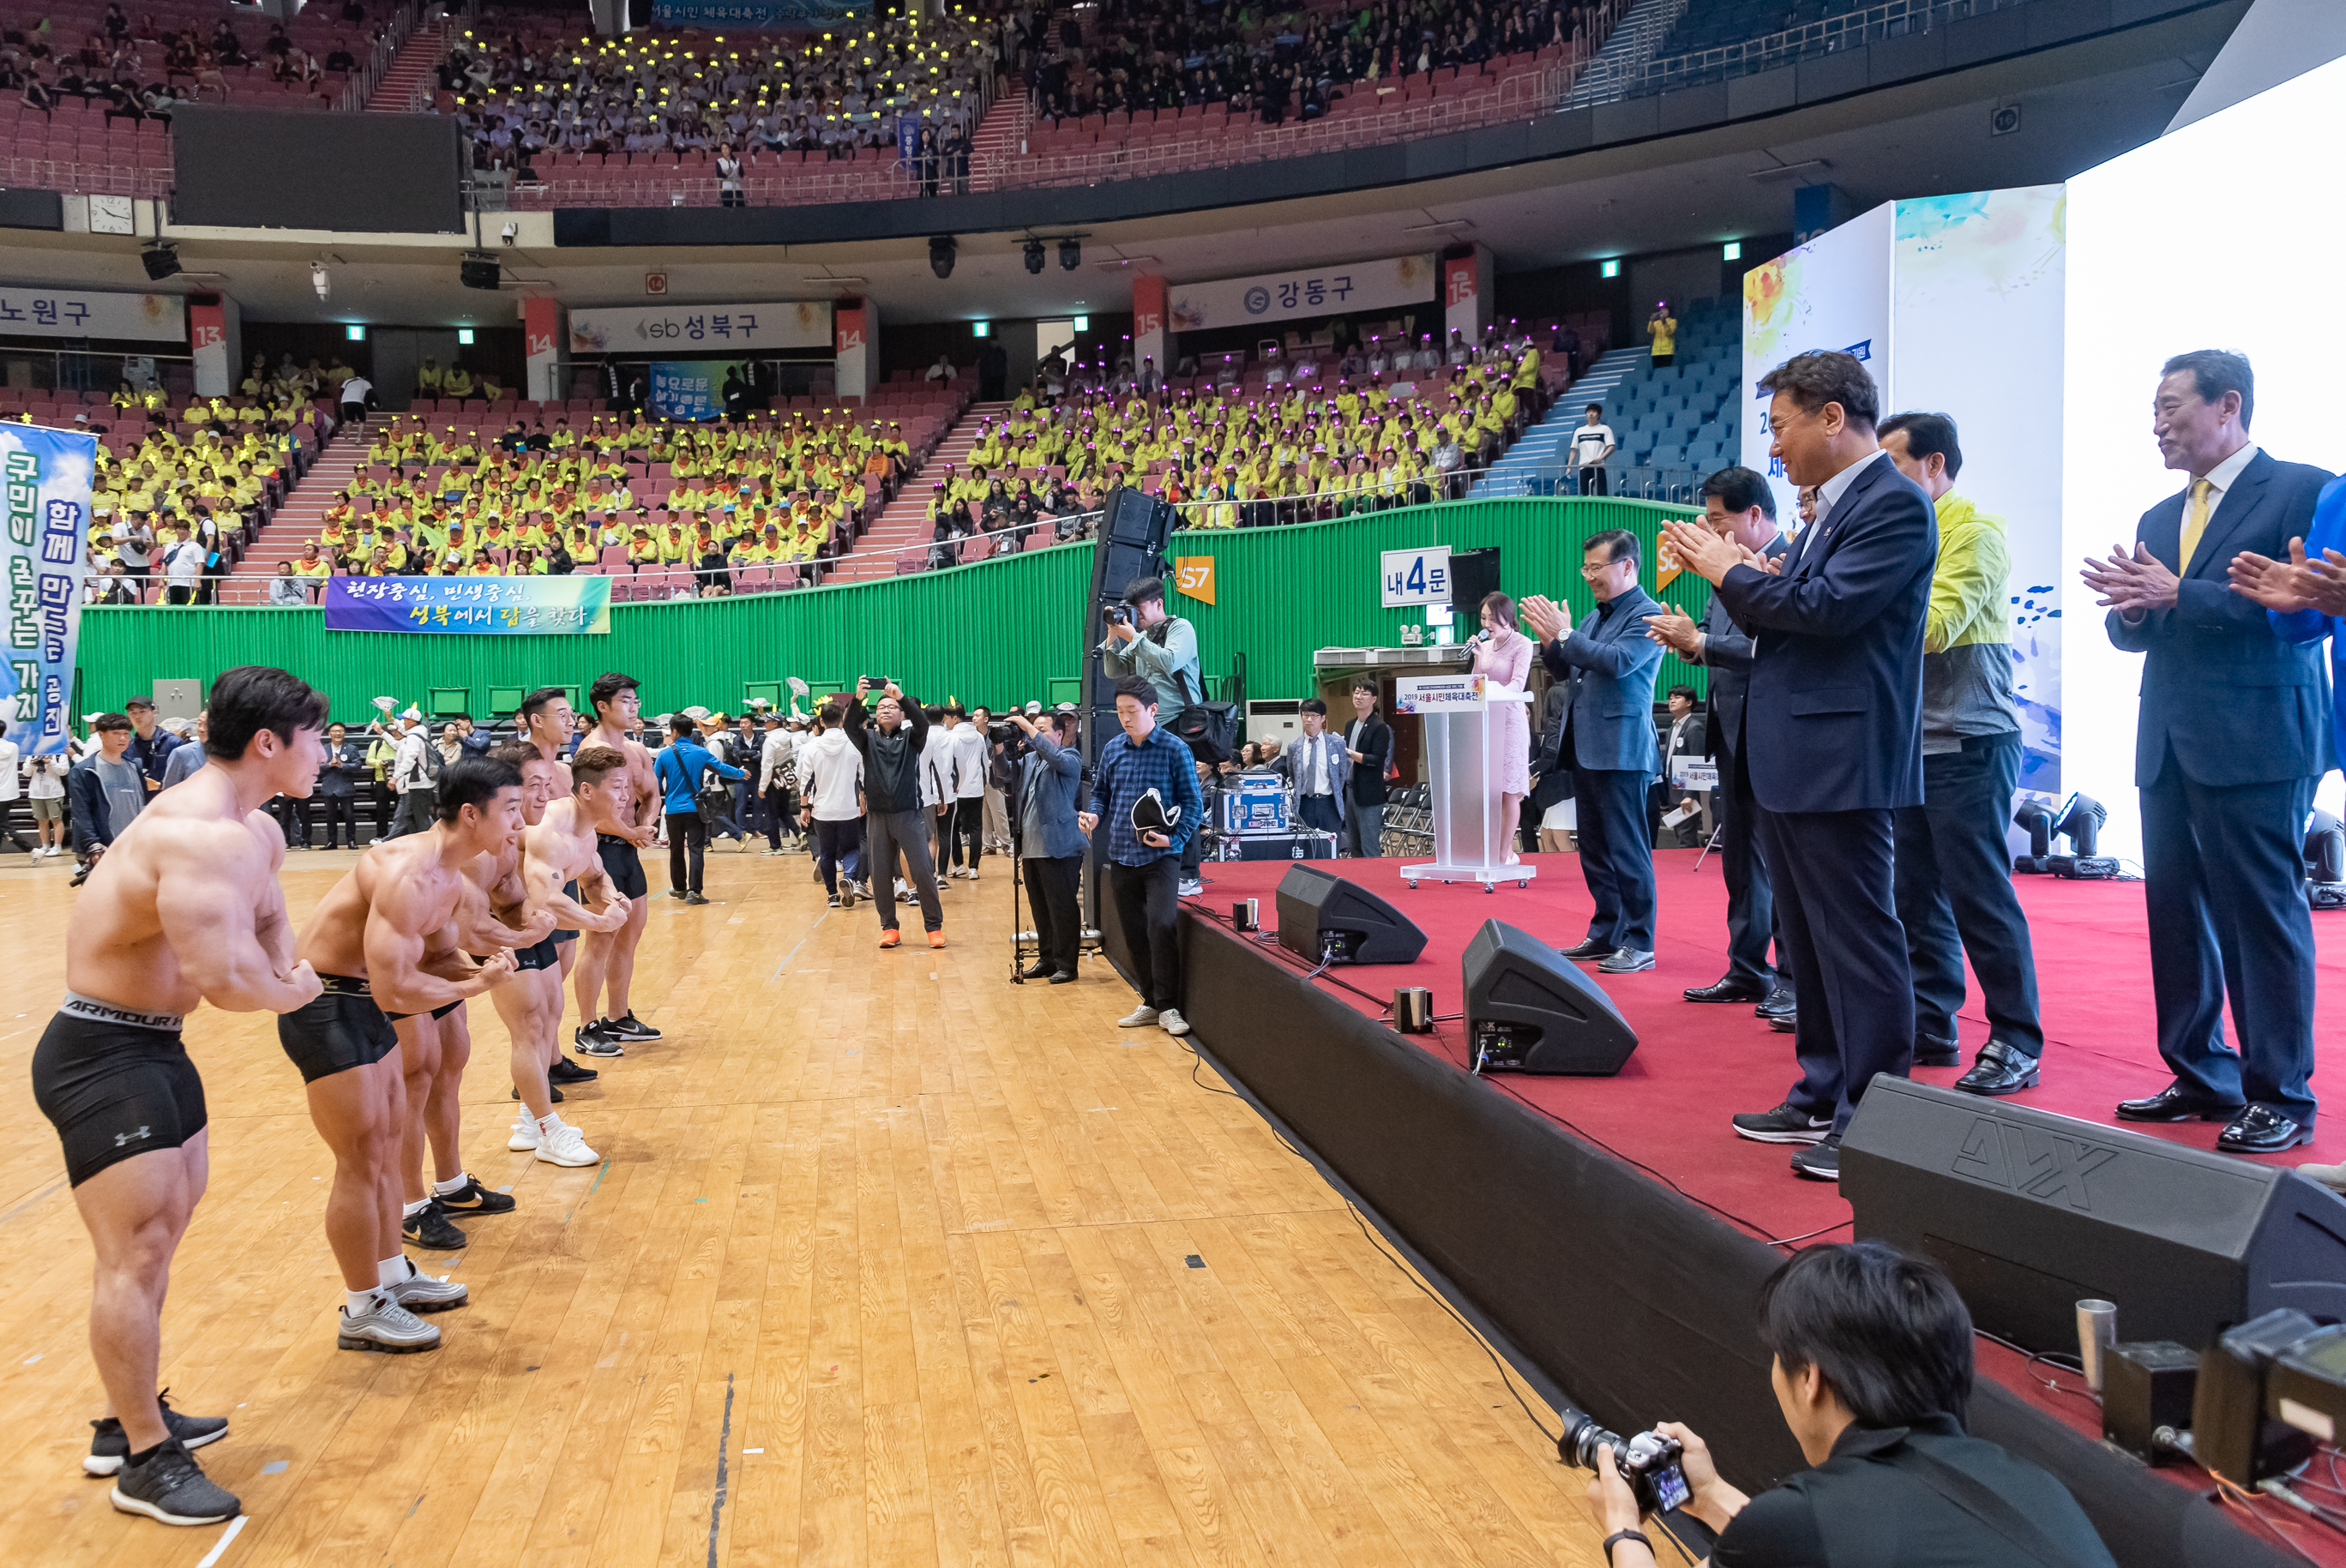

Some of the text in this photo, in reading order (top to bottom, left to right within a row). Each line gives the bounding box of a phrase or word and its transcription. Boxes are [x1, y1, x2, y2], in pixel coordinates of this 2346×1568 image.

[651, 279, 664, 289] 14
[1278, 276, 1355, 309] 강동구
[1449, 280, 1473, 304] 15
[0, 299, 91, 327] 노원구
[1137, 313, 1159, 335] 15
[196, 326, 221, 346] 13
[649, 314, 759, 340] sb 성북구
[528, 333, 553, 353] 14
[839, 329, 863, 350] 14
[7, 452, 39, 547] 구민이
[43, 499, 81, 564] 함께
[1180, 567, 1210, 589] S7
[346, 580, 532, 603] 현장중심, 민생중심,
[409, 604, 596, 628] 성북에서 답을 찾다.
[11, 660, 40, 722] 가치
[1418, 691, 1479, 703] 서울시민체육대축전
[66, 1000, 172, 1026] ARMOUR
